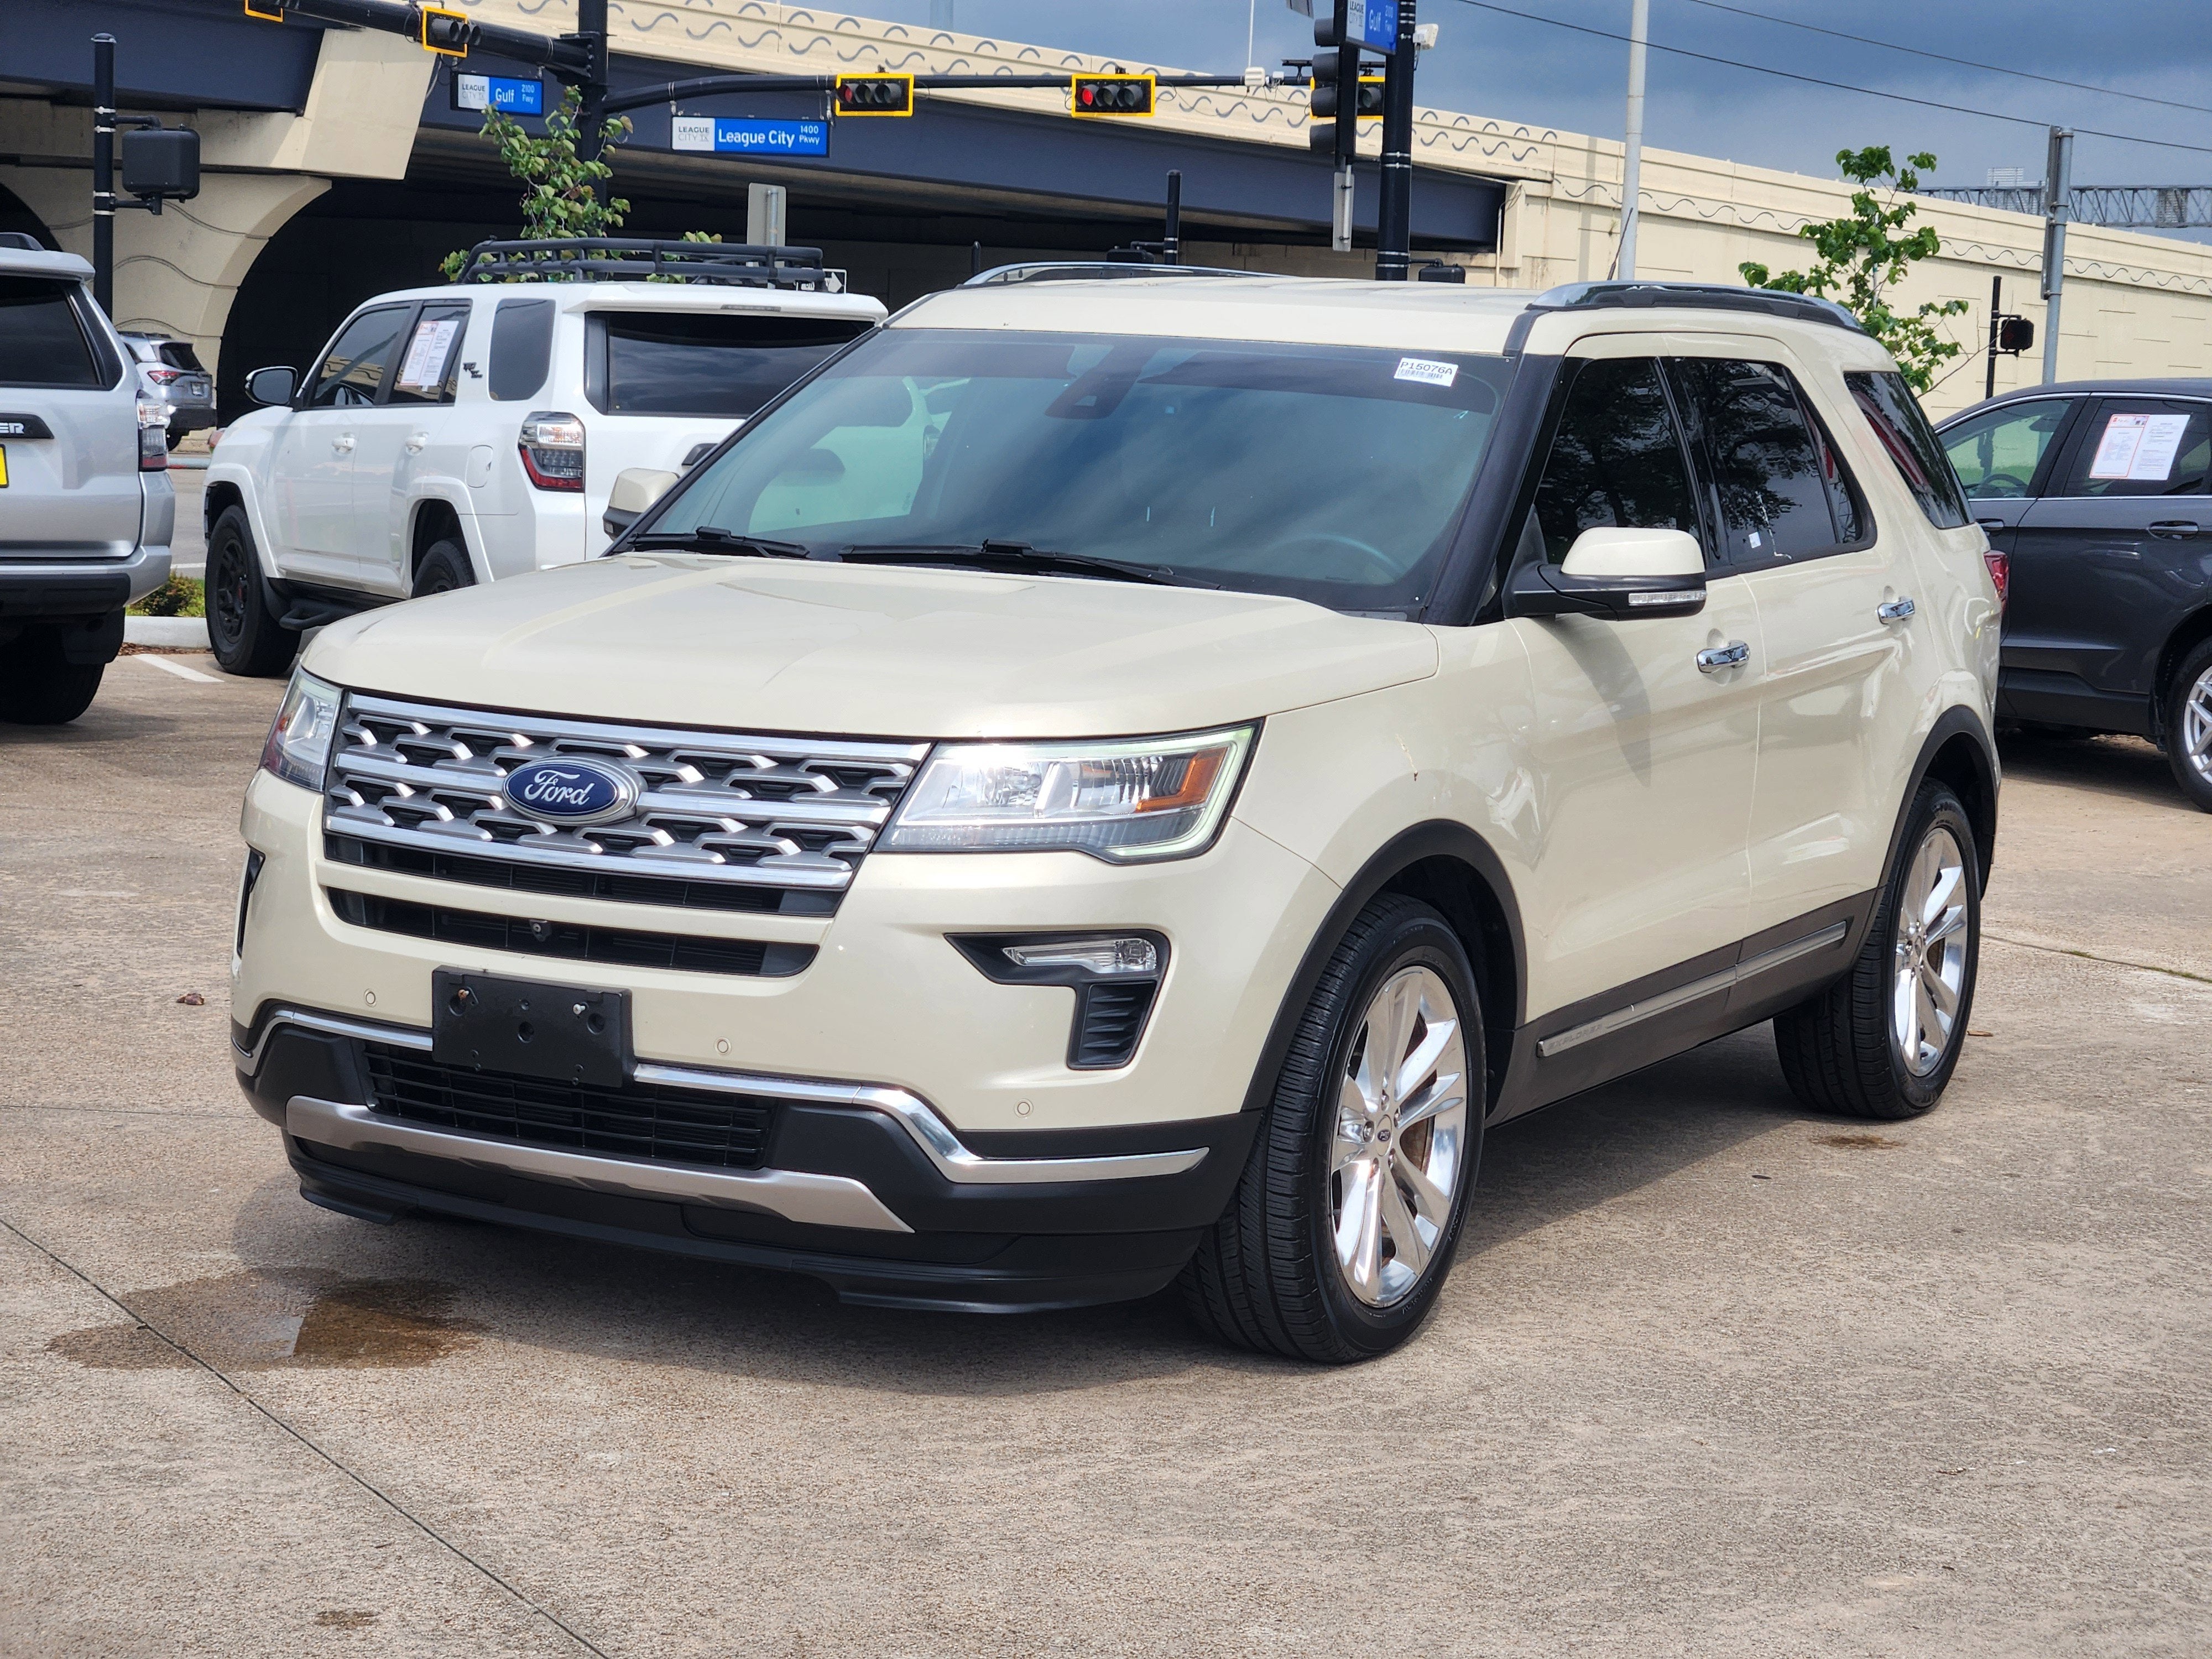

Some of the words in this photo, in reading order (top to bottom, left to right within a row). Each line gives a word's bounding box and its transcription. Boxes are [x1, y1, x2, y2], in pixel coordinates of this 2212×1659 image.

[1350, 1, 1364, 14] LEAGUE
[1369, 9, 1381, 32] Gulf
[521, 84, 535, 93] 2100
[495, 88, 514, 103] Gulf
[522, 94, 534, 105] Fwy
[800, 125, 818, 134] 1400
[718, 128, 765, 147] League
[769, 129, 795, 148] City
[799, 134, 820, 145] Pkwy
[1400, 362, 1452, 375] P15076A
[525, 770, 594, 805] Ford
